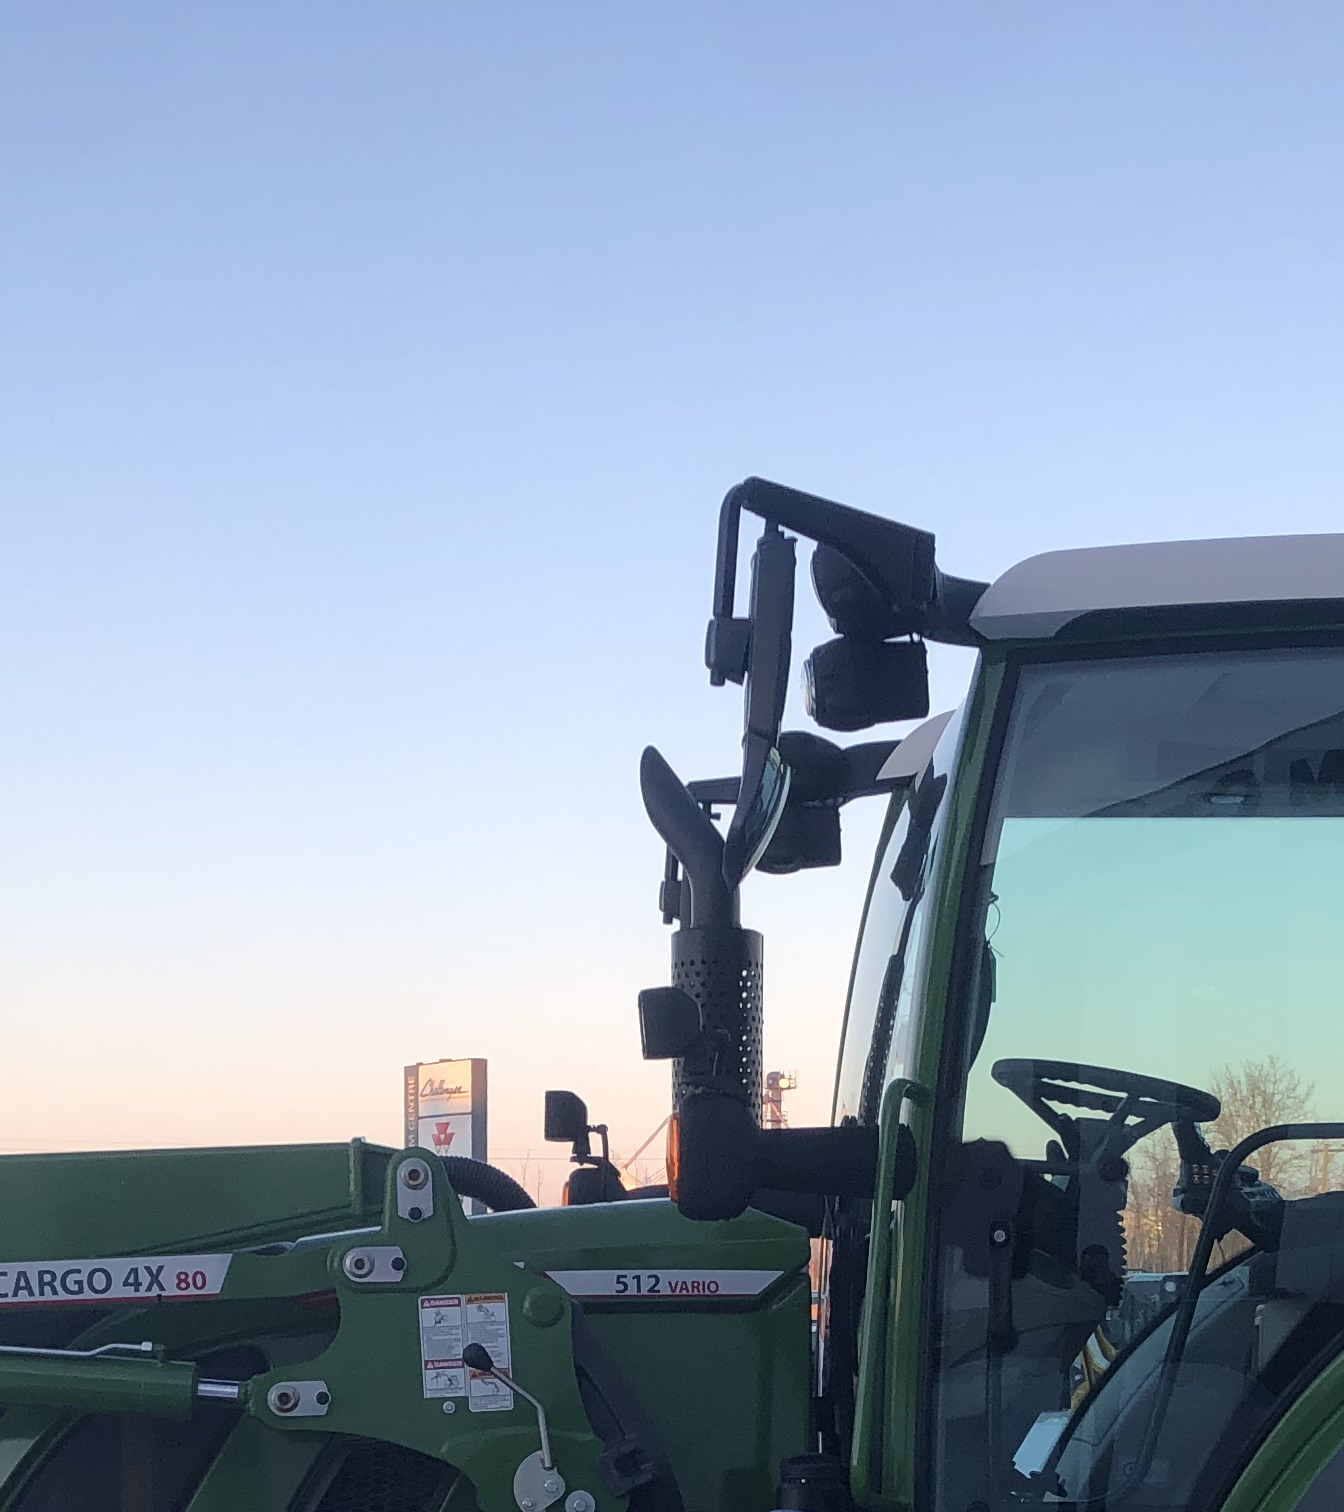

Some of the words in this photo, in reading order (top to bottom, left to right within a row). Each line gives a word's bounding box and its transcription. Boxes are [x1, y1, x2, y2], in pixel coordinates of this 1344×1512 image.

[122, 1265, 166, 1293] 4X
[175, 1270, 207, 1292] 80
[615, 1274, 661, 1294] 512
[668, 1280, 720, 1294] VARIO
